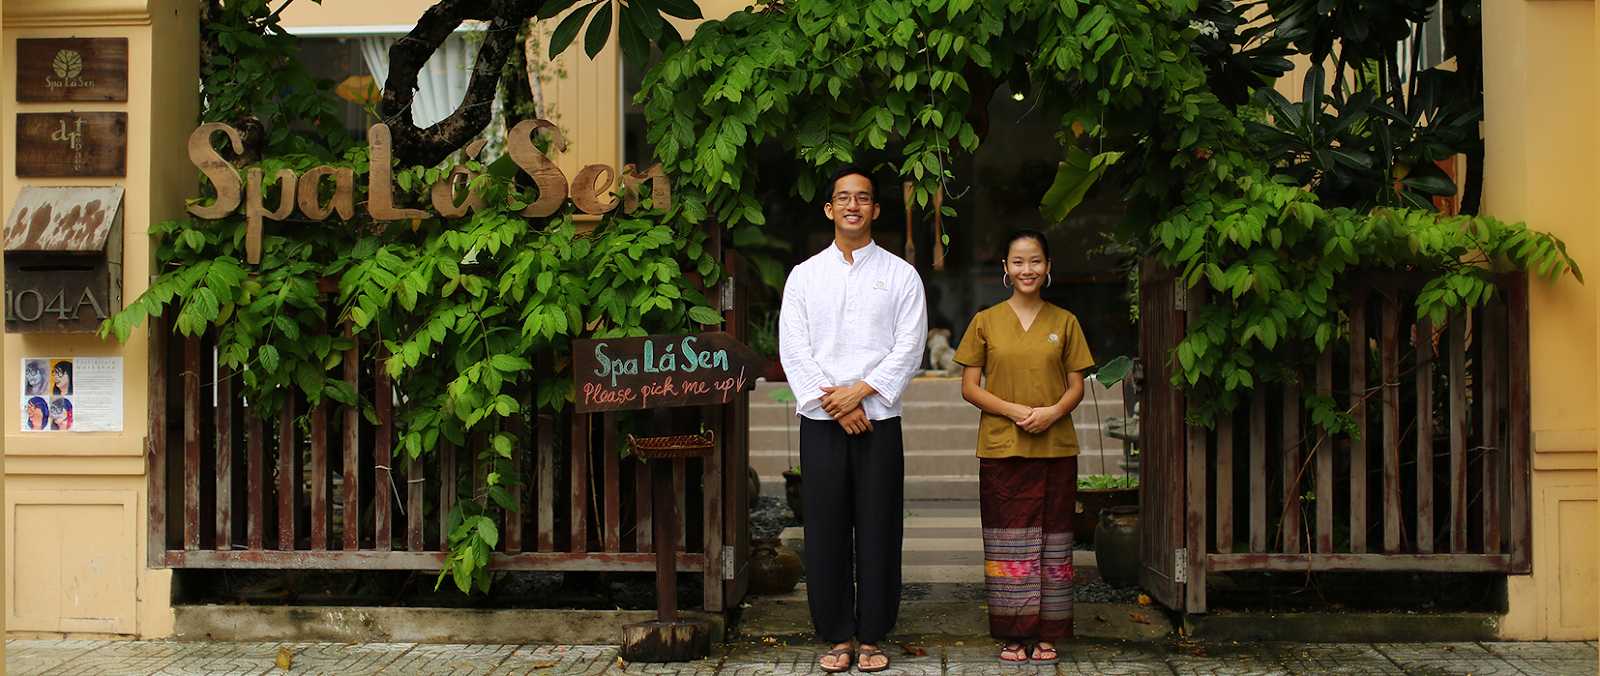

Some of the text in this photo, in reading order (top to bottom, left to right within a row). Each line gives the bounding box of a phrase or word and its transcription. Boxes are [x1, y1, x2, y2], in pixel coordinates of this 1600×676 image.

[45, 76, 63, 91] Spa
[186, 121, 355, 264] Spa
[507, 118, 672, 218] Sen
[5, 286, 108, 322] 104A
[594, 335, 730, 388] Spa Lá Sen
[583, 375, 735, 409] Please pick me up
